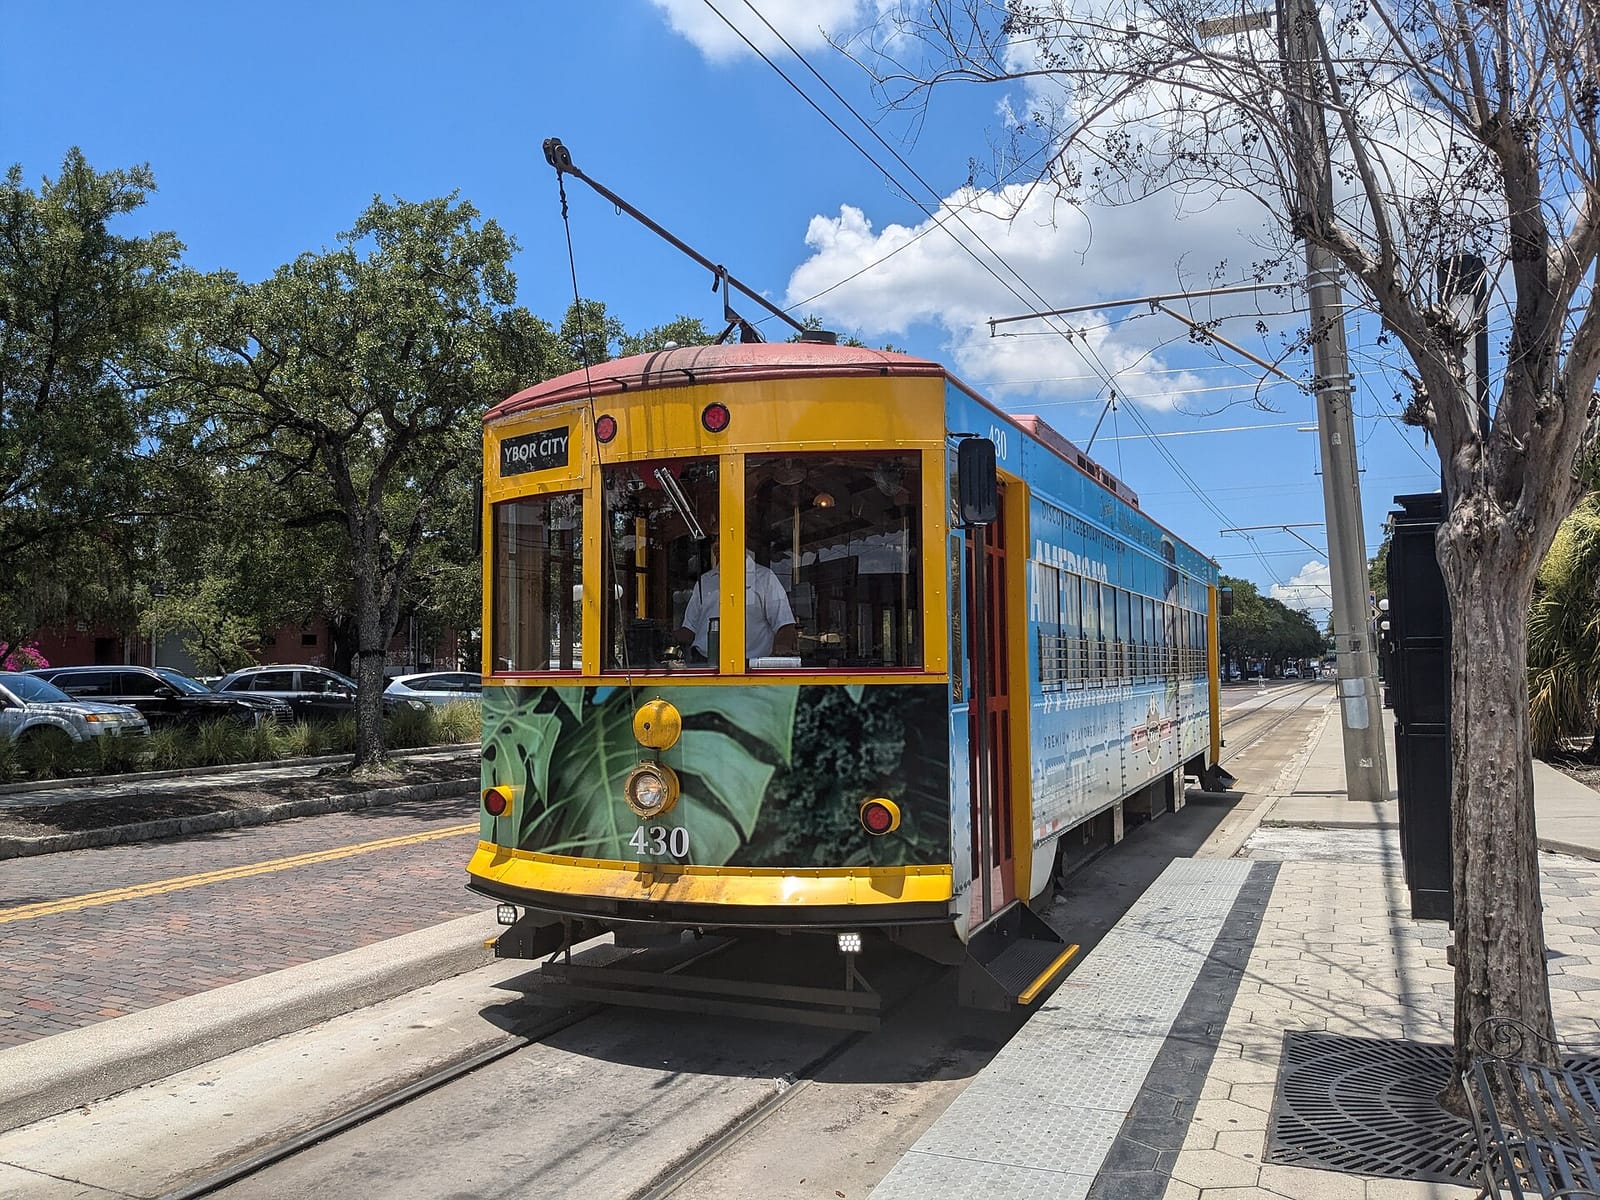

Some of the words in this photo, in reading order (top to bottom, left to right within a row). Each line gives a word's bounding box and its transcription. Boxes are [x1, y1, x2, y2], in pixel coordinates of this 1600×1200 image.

[504, 442, 537, 463] YBOR
[540, 435, 568, 456] CITY
[1043, 730, 1070, 751] PREMIUM
[629, 825, 690, 858] 430
